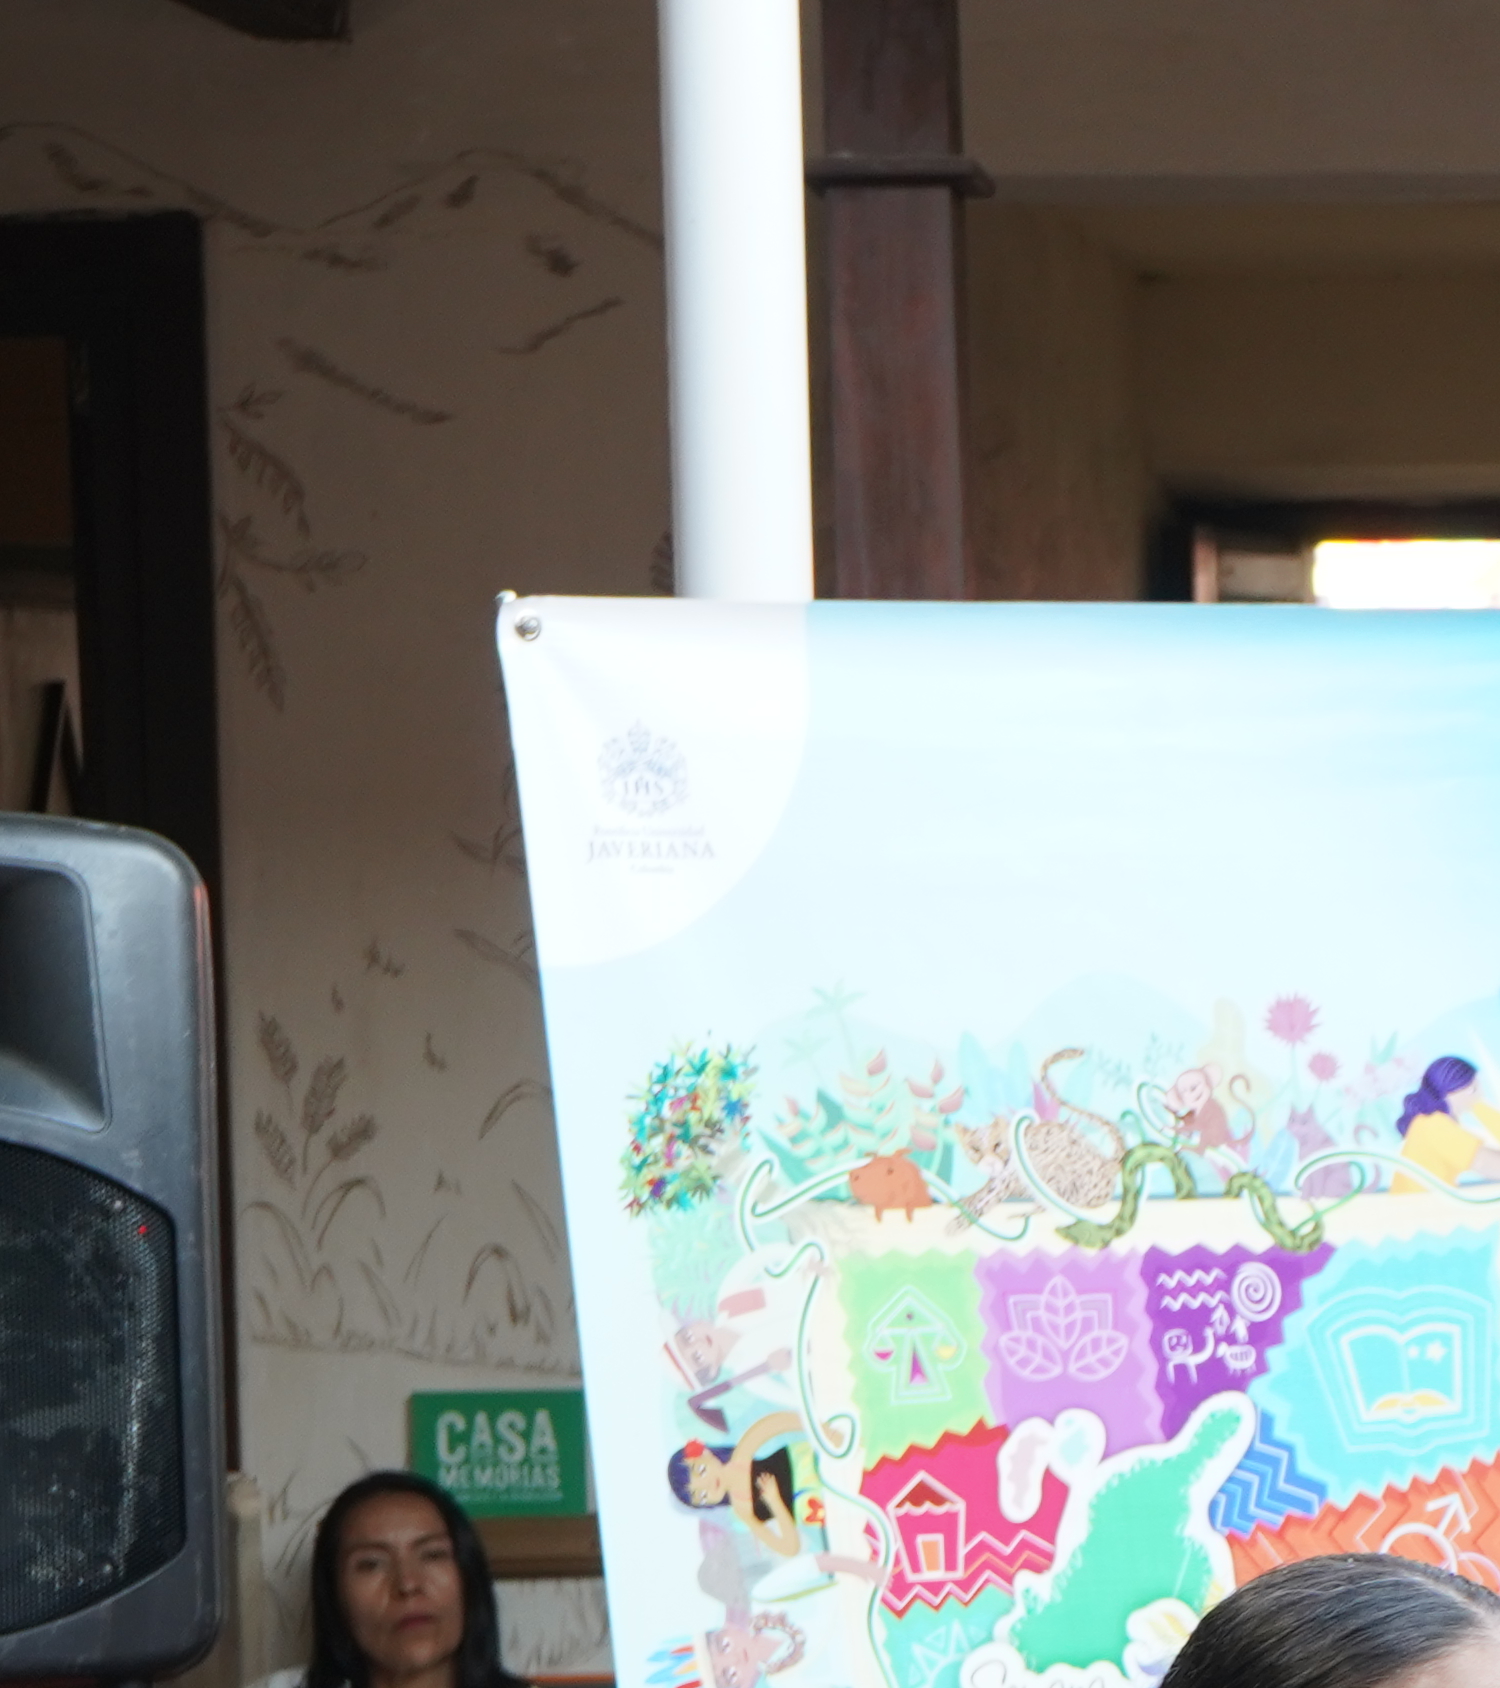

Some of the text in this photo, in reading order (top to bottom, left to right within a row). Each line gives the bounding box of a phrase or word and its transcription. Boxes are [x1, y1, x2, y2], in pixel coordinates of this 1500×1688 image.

[586, 840, 716, 864] JAVERIANA
[435, 1408, 559, 1464] CASA
[437, 1464, 562, 1489] MEMORIAS
